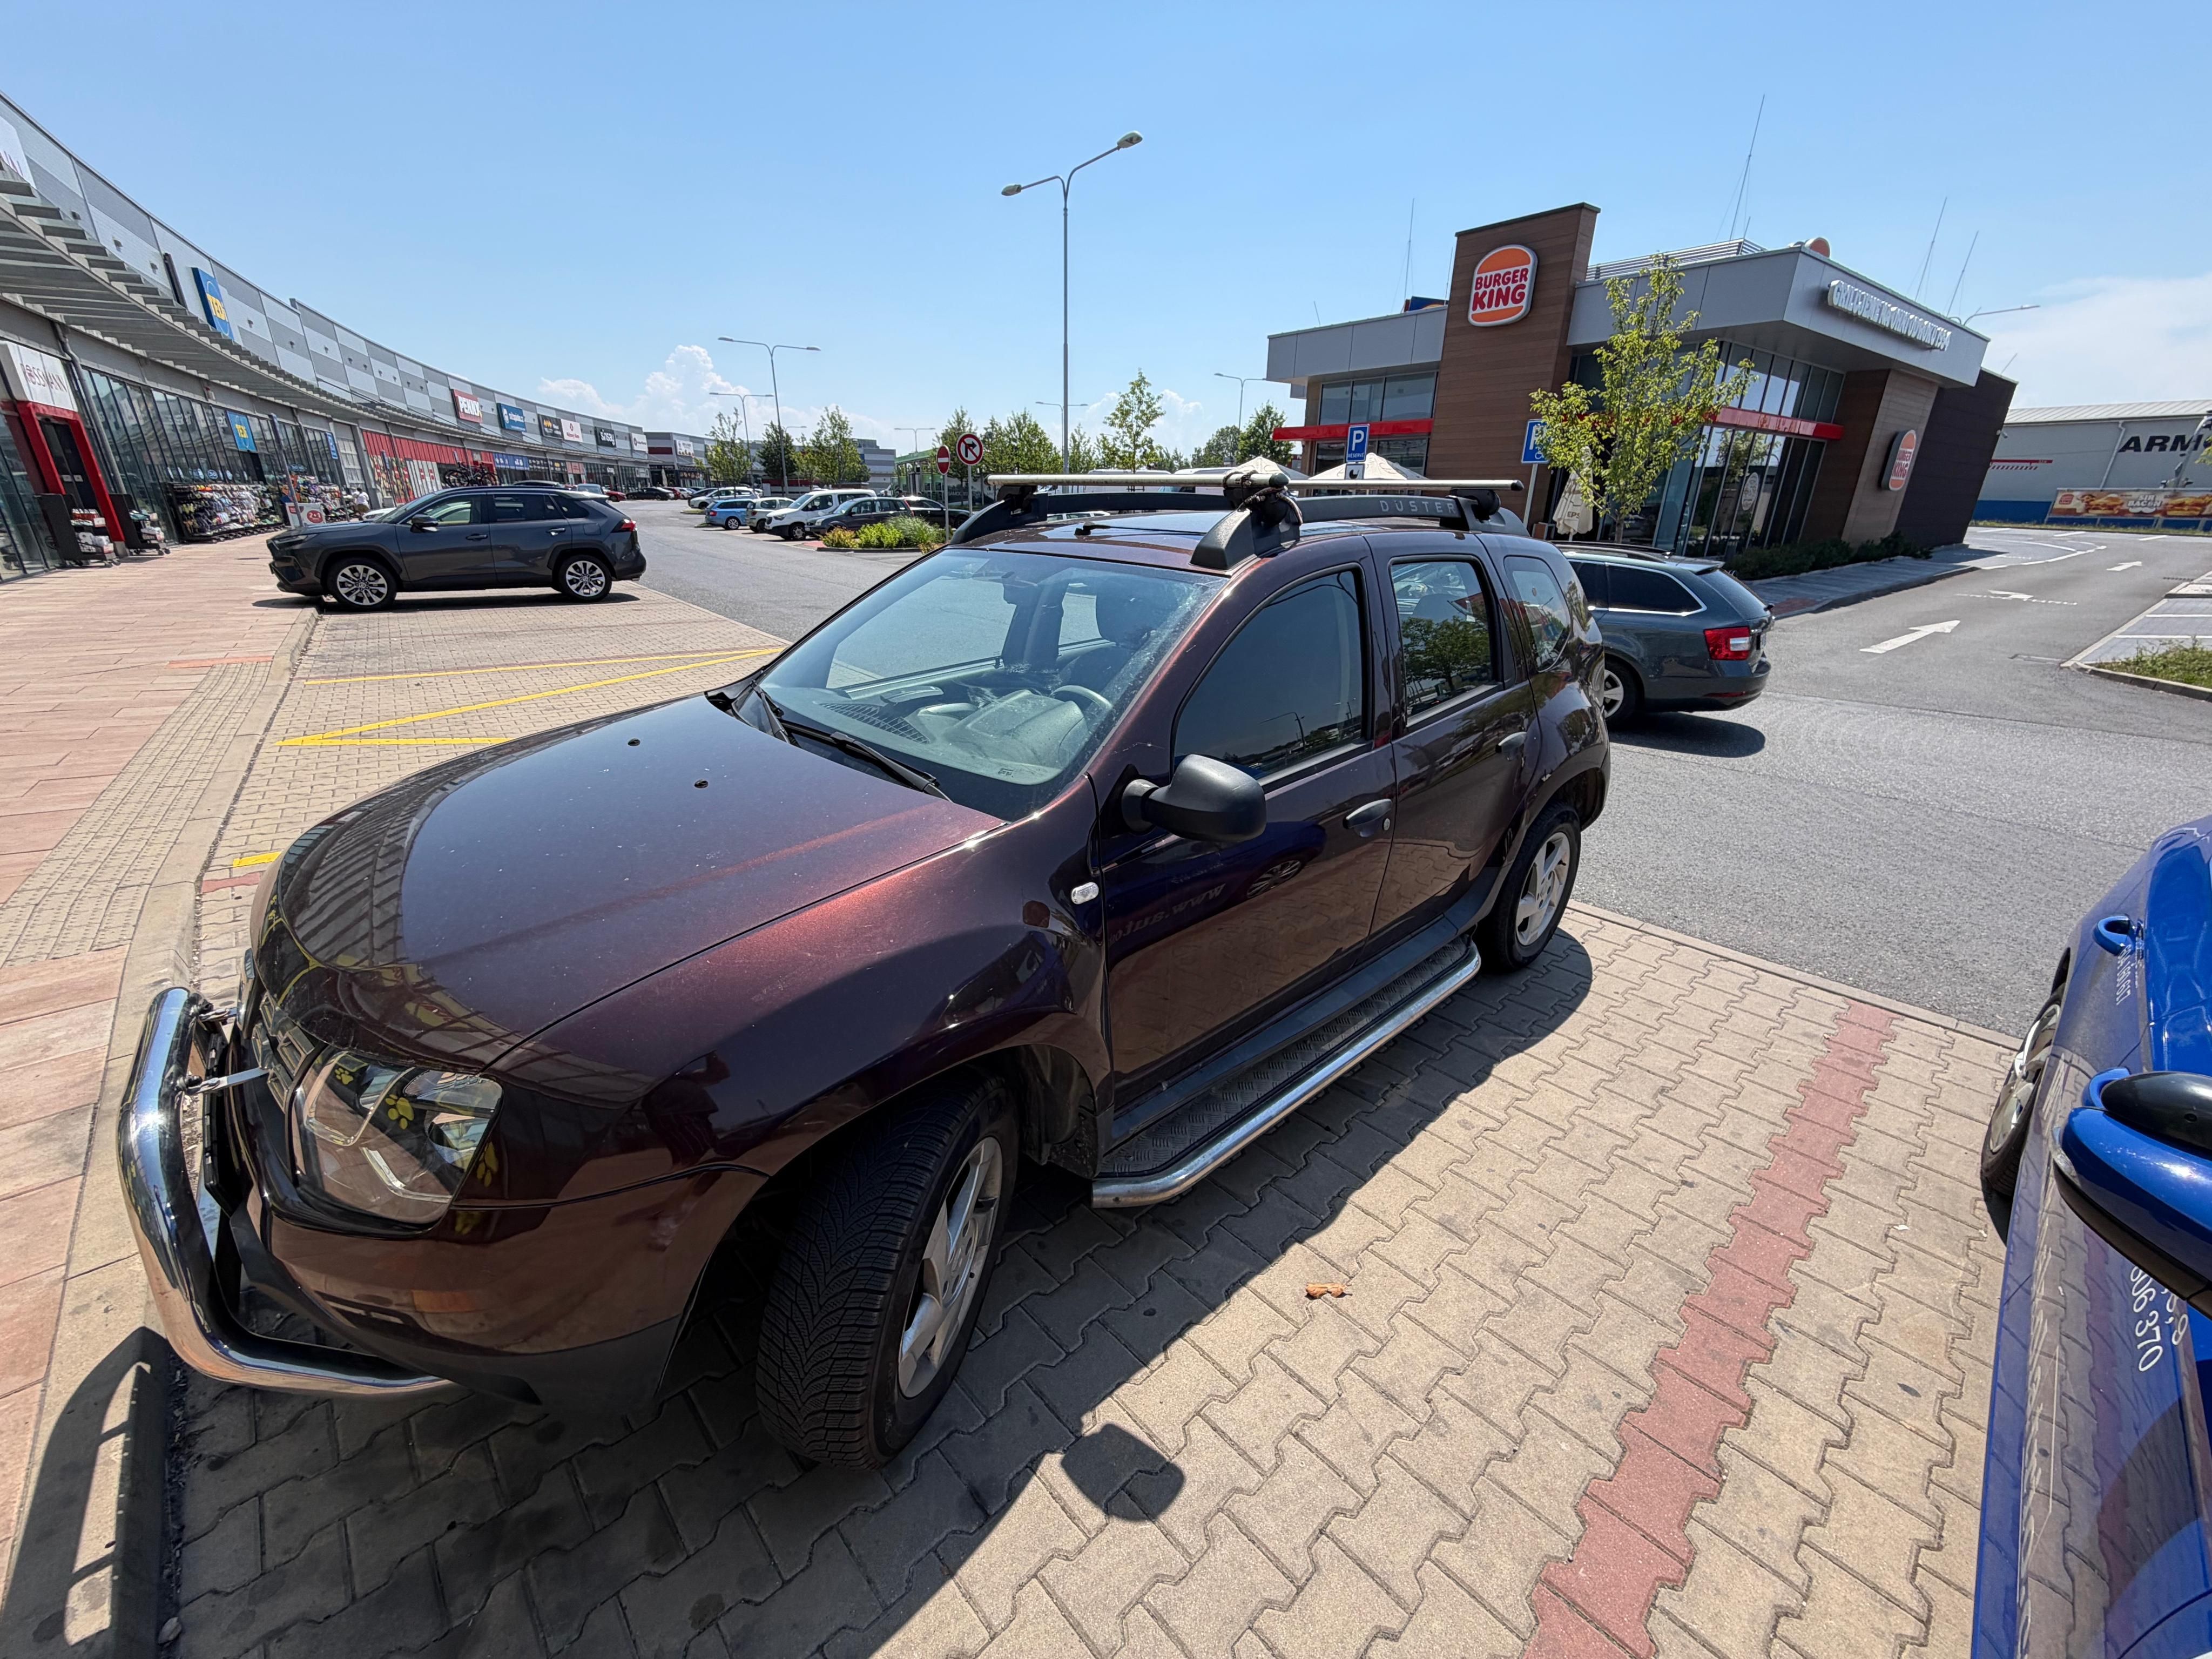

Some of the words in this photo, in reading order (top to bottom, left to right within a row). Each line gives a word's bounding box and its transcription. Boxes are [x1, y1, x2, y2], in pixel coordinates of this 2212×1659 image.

[1475, 268, 1529, 291] BURGER
[1472, 284, 1526, 311] KING
[20, 363, 68, 393] ROSSMANN
[457, 395, 481, 416] PENNY
[1352, 430, 1364, 451] P
[1379, 500, 1455, 513] DUSTER
[2135, 1310, 2163, 1372] 370
